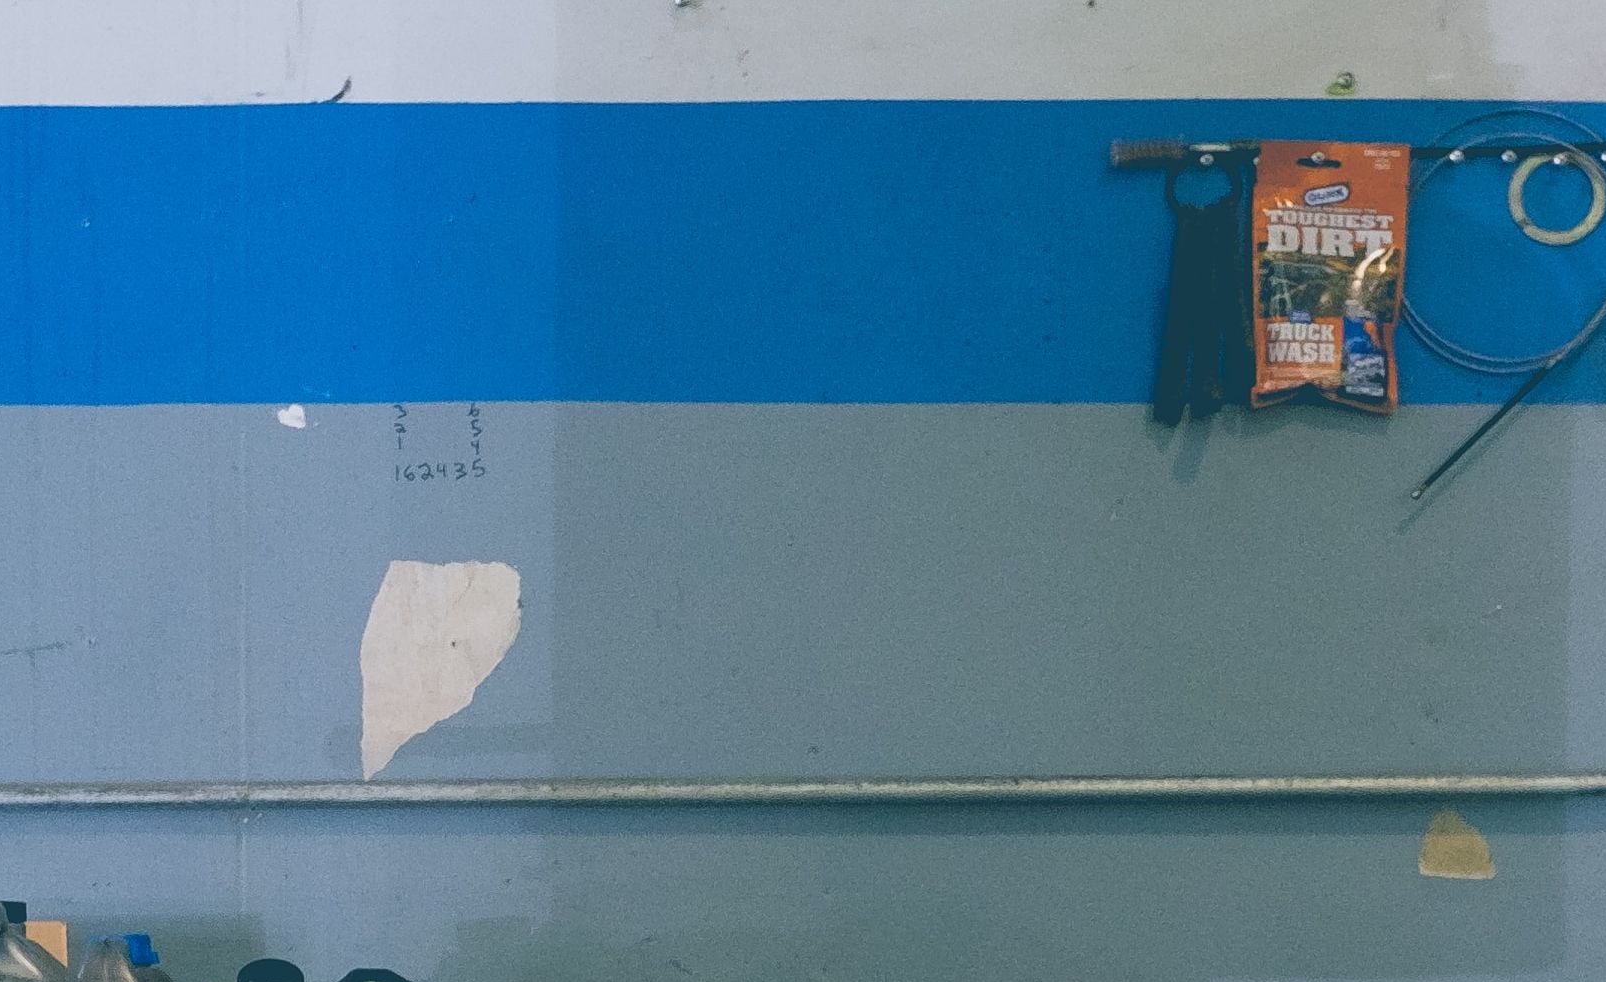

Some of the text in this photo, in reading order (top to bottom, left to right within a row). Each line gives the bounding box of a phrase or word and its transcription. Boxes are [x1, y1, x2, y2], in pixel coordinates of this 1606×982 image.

[1267, 210, 1393, 229] TOUGHEST
[1266, 224, 1393, 257] DIRT
[1266, 323, 1335, 342] TRUCK
[1266, 342, 1335, 363] WASH
